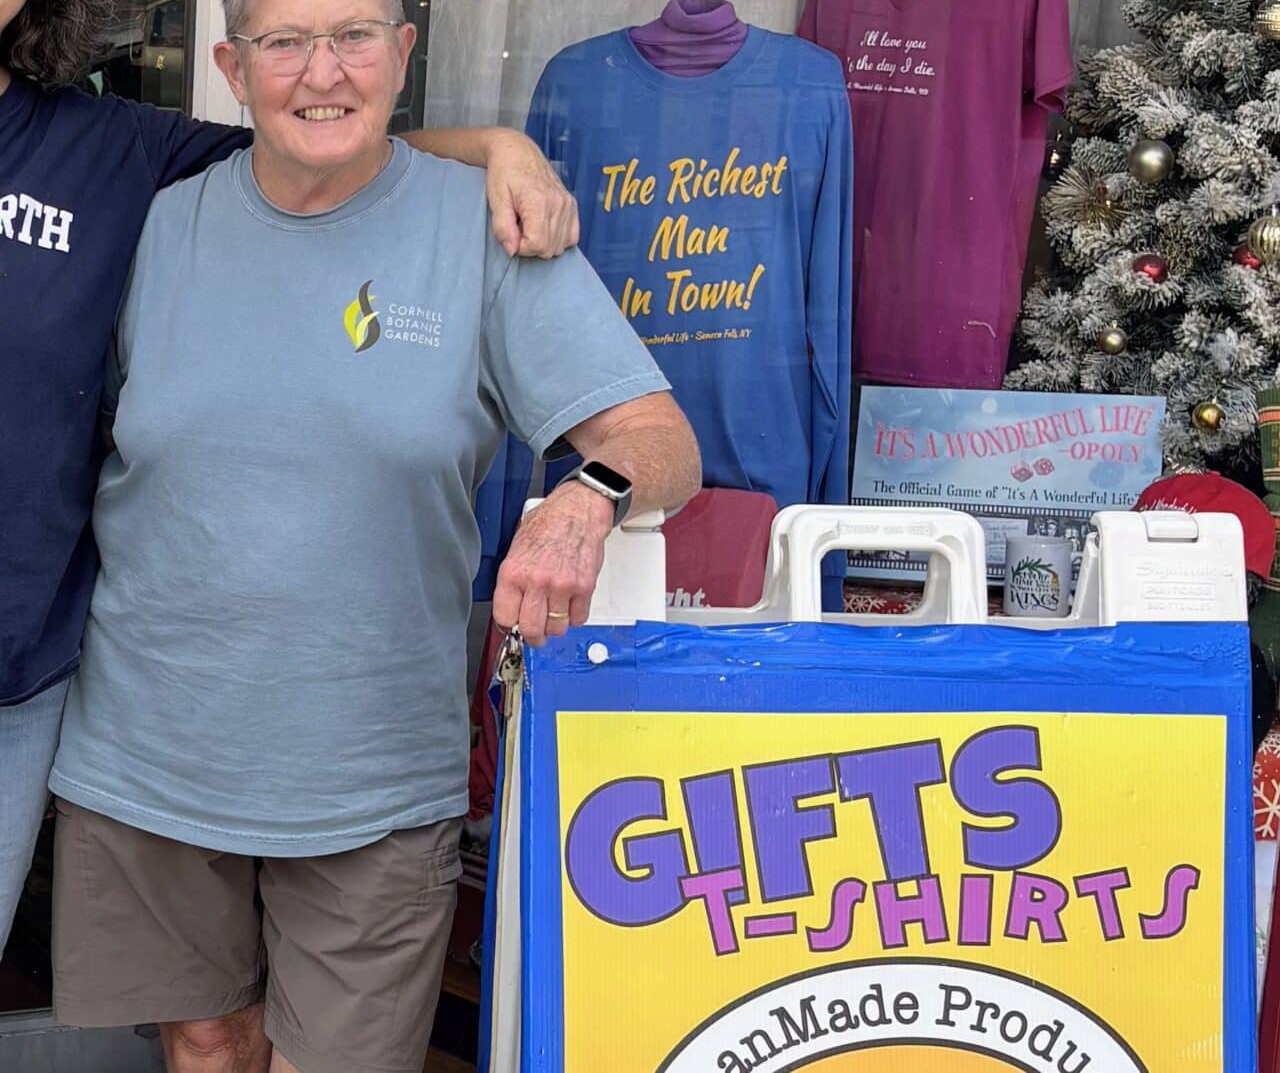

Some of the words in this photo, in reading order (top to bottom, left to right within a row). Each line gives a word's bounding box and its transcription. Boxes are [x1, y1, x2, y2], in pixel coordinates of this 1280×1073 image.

[880, 31, 901, 47] love
[905, 39, 927, 54] you
[856, 54, 873, 70] the
[876, 58, 896, 78] day
[900, 57, 912, 73] I
[602, 158, 656, 212] The
[667, 147, 788, 205] Richest
[648, 214, 729, 262] Man
[621, 277, 652, 318] In
[666, 263, 766, 315] Town!
[386, 316, 441, 335] BOTANIC
[389, 303, 442, 322] CORNELL
[384, 329, 440, 347] GARDENS
[922, 432, 938, 458] A
[946, 408, 1095, 460] WONDERFUL
[873, 480, 895, 494] The
[899, 479, 942, 496] Official
[946, 484, 981, 497] Game
[985, 484, 999, 498] of
[1030, 488, 1039, 501] A
[1044, 488, 1108, 505] Wonderful
[566, 724, 1063, 926] GIFTS
[679, 863, 1201, 957] T-SHIRTS
